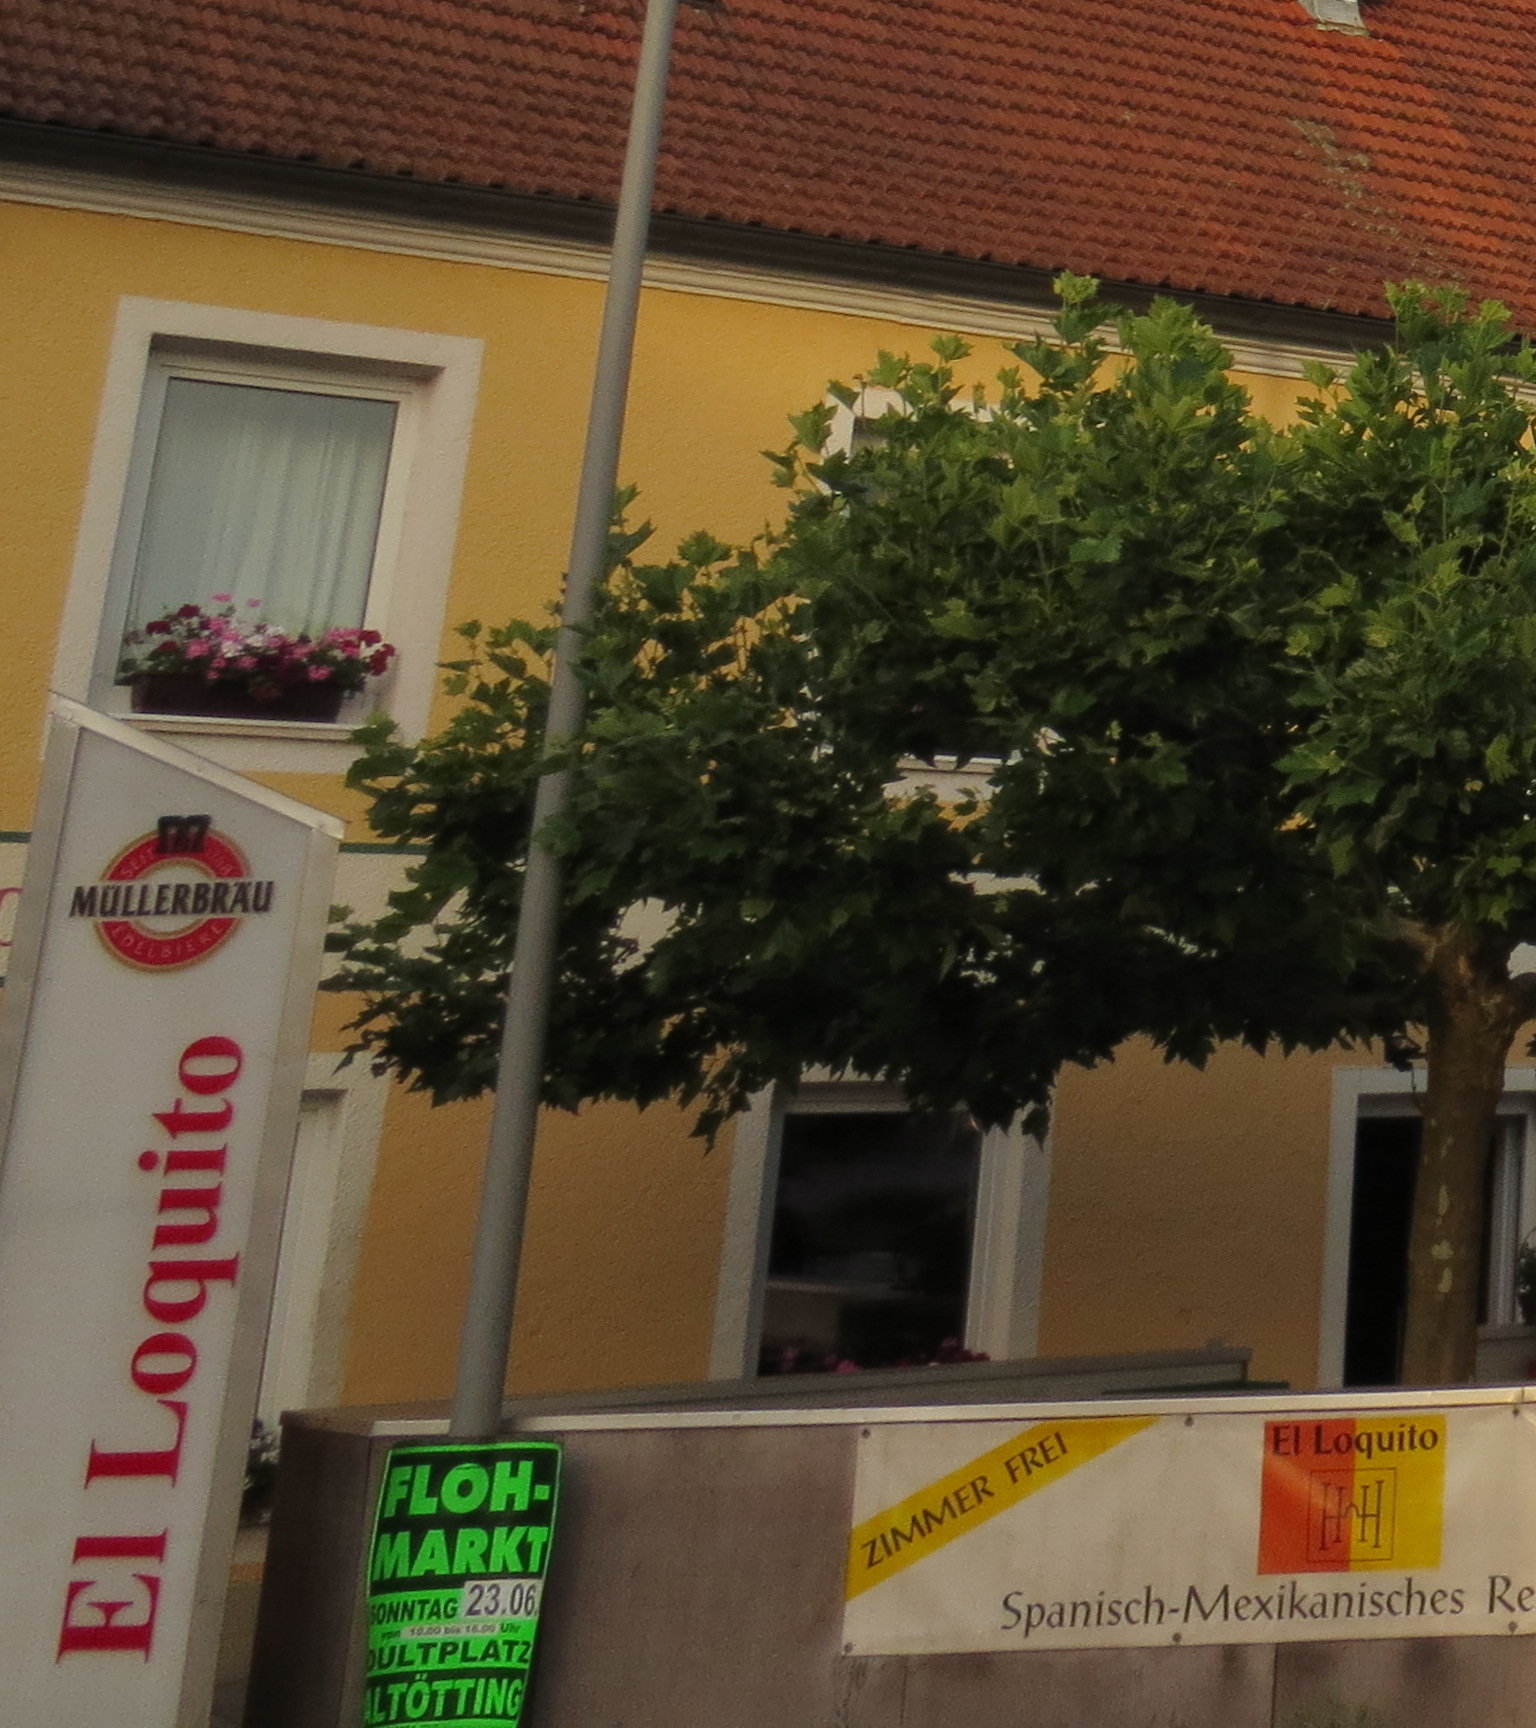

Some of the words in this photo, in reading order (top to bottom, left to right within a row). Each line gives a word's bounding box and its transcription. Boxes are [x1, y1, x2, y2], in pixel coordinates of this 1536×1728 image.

[69, 880, 275, 918] MÜLLERBRÄU
[86, 1034, 246, 1490] Loquito
[1272, 1424, 1302, 1457] El
[1314, 1423, 1438, 1460] Loquito
[383, 1460, 550, 1518] FLOH-
[860, 1474, 996, 1570] ZIMMER
[1003, 1431, 1069, 1485] FREI
[371, 1525, 550, 1581] MARKT
[56, 1527, 169, 1666] El
[1000, 1576, 1466, 1638] Spanisch-Mexikanisches
